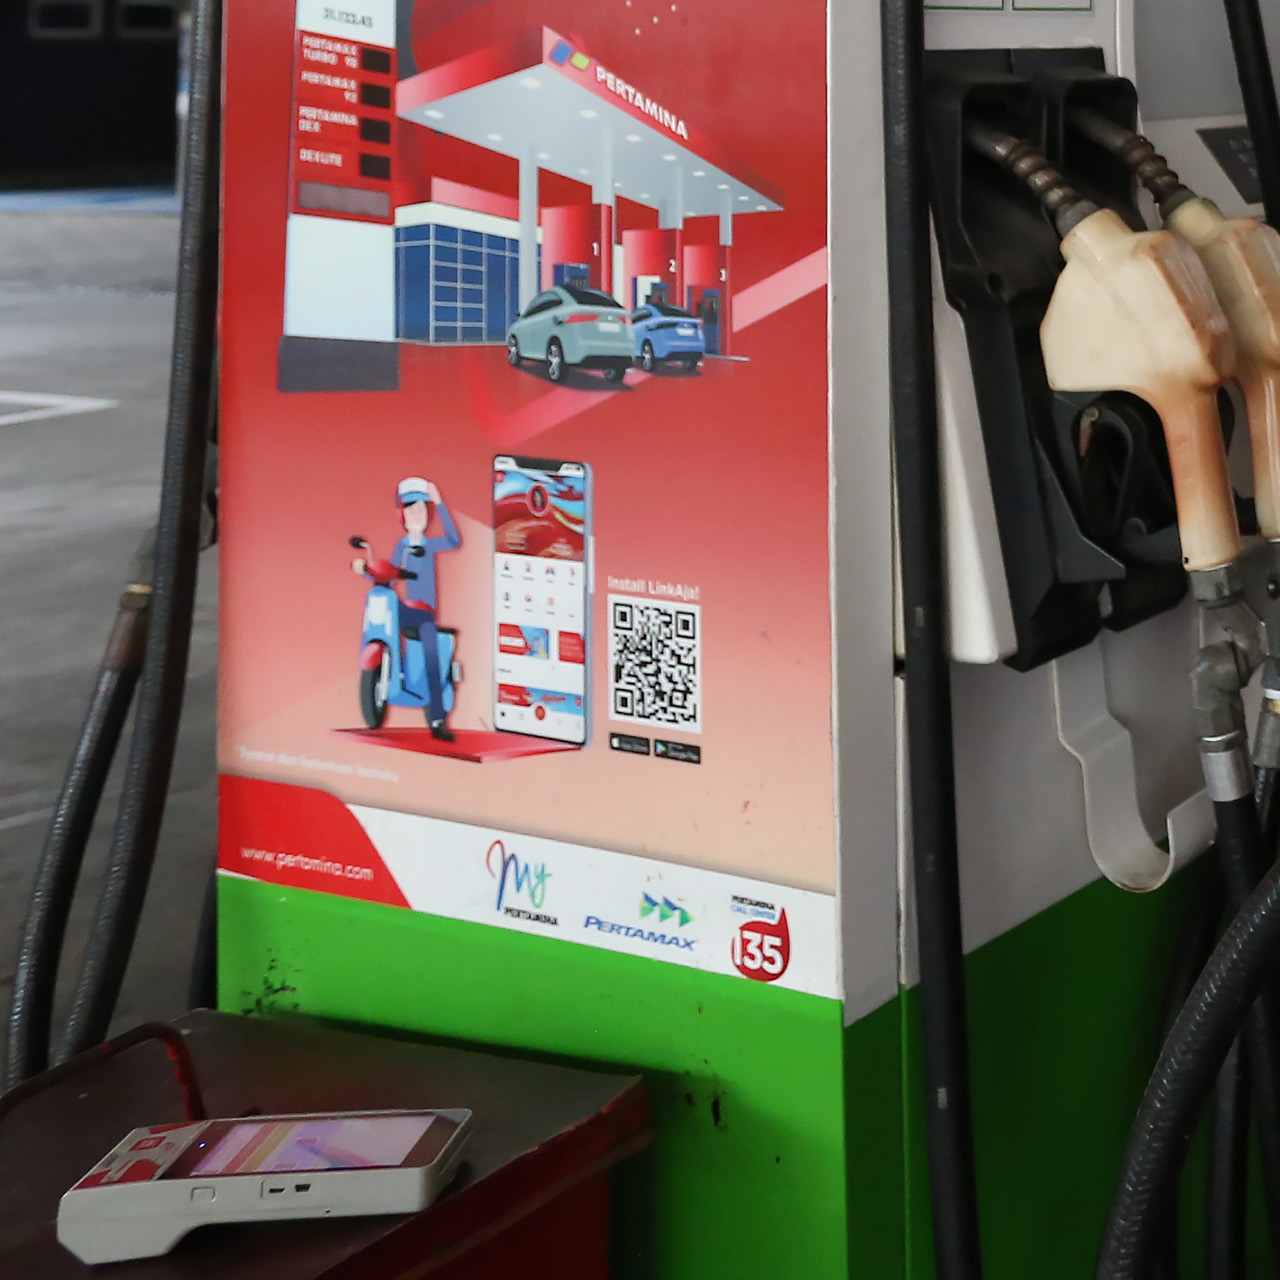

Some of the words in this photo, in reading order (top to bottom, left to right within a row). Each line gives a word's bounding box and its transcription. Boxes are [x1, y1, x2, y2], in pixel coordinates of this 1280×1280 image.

[596, 65, 690, 141] PERTAMINA
[592, 241, 600, 256] 1
[668, 258, 677, 273] 2
[719, 268, 728, 282] 3
[607, 574, 646, 593] Install
[240, 847, 374, 881] www.pertamina.com
[583, 915, 696, 951] PERTAMAX
[734, 929, 784, 975] 135
